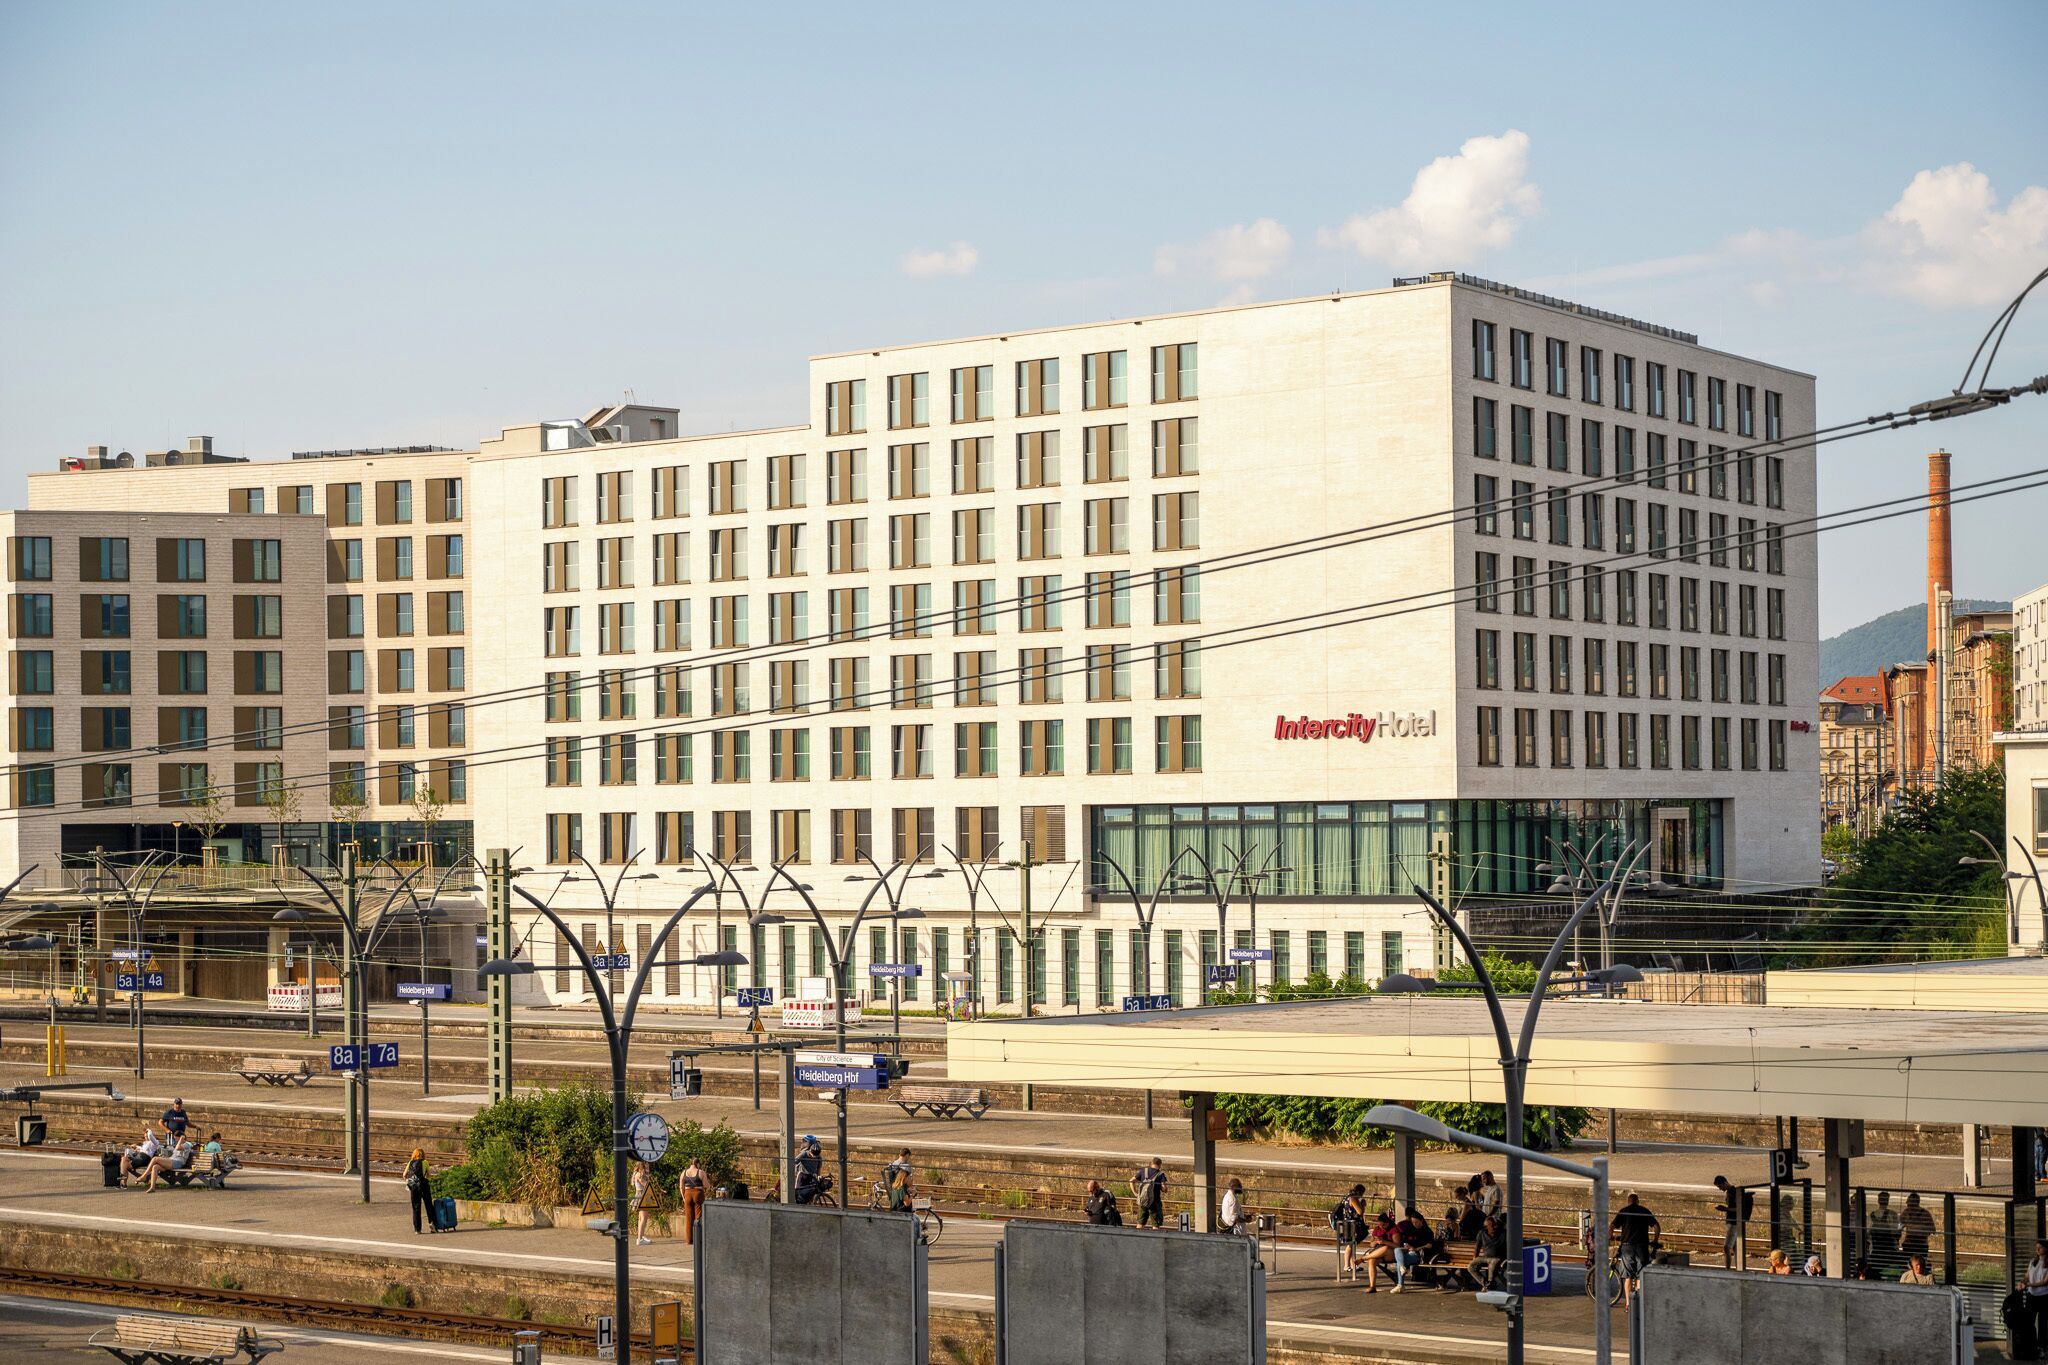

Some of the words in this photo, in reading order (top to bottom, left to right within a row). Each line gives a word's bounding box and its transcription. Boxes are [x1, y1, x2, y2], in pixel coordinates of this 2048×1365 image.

[593, 955, 606, 967] 3a
[617, 955, 629, 966] 2a
[1231, 950, 1255, 958] Heidelberg
[871, 965, 896, 974] Heidelberg
[1211, 966, 1219, 979] A
[1228, 965, 1236, 977] A
[119, 974, 133, 987] 5a
[148, 973, 163, 986] 4a
[400, 986, 425, 996] Heidelberg
[425, 986, 435, 994] Hbf
[740, 988, 750, 1003] A
[763, 988, 772, 1002] A
[1126, 997, 1140, 1011] 5a
[1155, 994, 1170, 1009] 4a
[333, 1046, 354, 1065] 8a
[377, 1043, 397, 1063] 7a
[816, 1054, 826, 1062] City
[833, 1055, 853, 1063] Science
[672, 1061, 683, 1085] H
[798, 1069, 843, 1085] Heidelberg
[844, 1071, 860, 1084] Hbf
[1776, 1151, 1787, 1178] B
[1180, 1214, 1189, 1232] H
[1533, 1247, 1549, 1284] B
[599, 1318, 611, 1345] H
